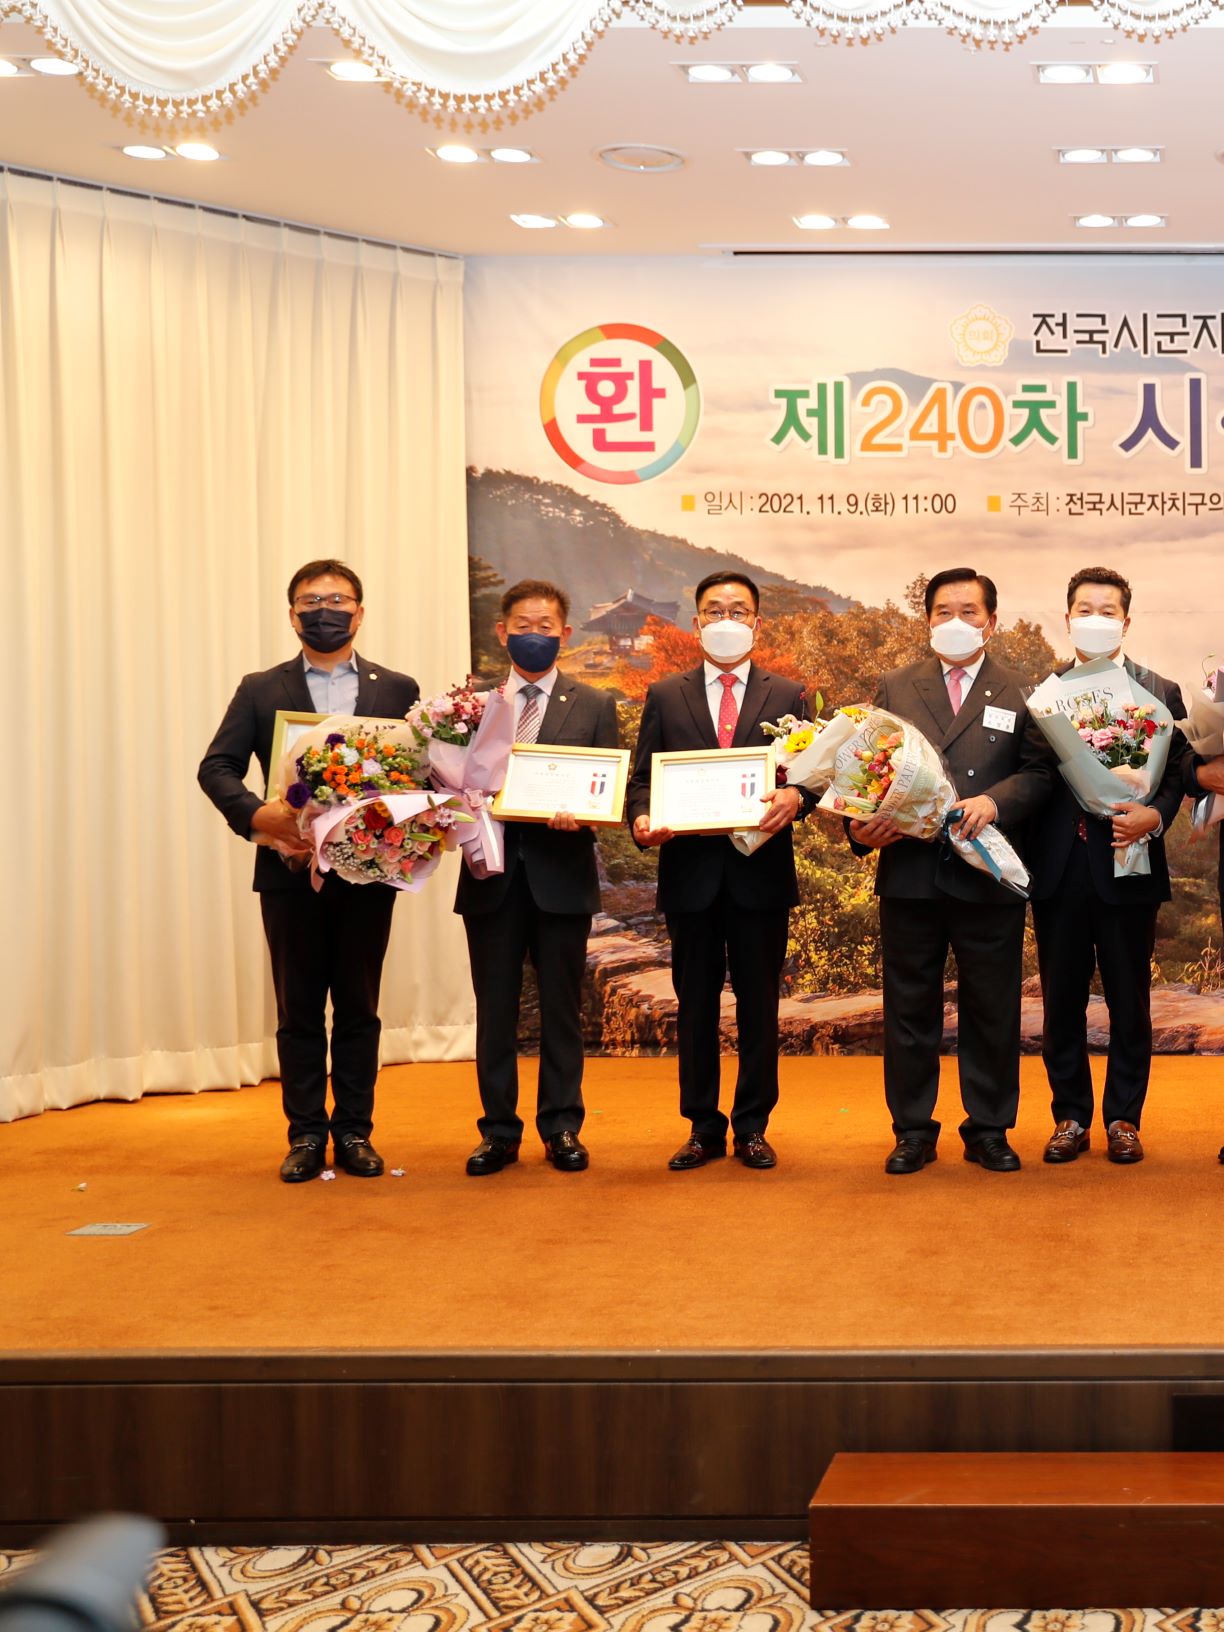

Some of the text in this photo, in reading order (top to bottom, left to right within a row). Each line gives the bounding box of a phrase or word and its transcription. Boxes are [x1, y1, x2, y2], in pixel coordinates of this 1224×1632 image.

[576, 358, 666, 452] 환
[770, 380, 1089, 460] 제240차
[901, 493, 957, 515] 11:00
